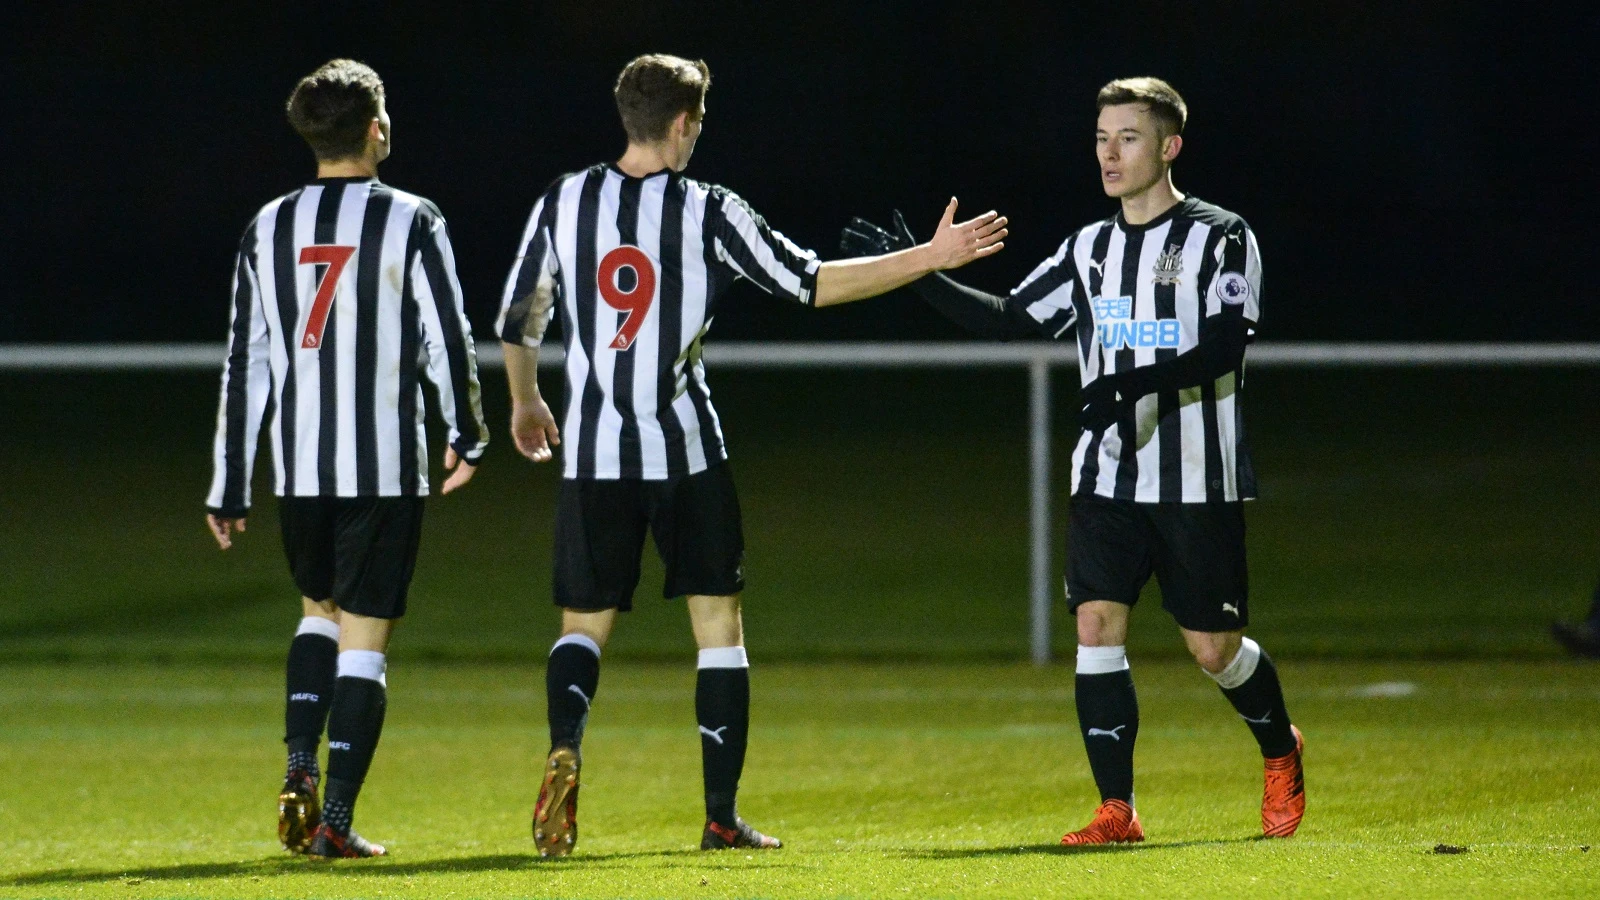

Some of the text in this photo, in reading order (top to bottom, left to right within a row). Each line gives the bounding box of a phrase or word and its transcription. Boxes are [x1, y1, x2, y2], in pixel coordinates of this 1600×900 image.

[299, 244, 357, 349] 7
[596, 245, 656, 350] 9
[291, 693, 319, 702] NUFC
